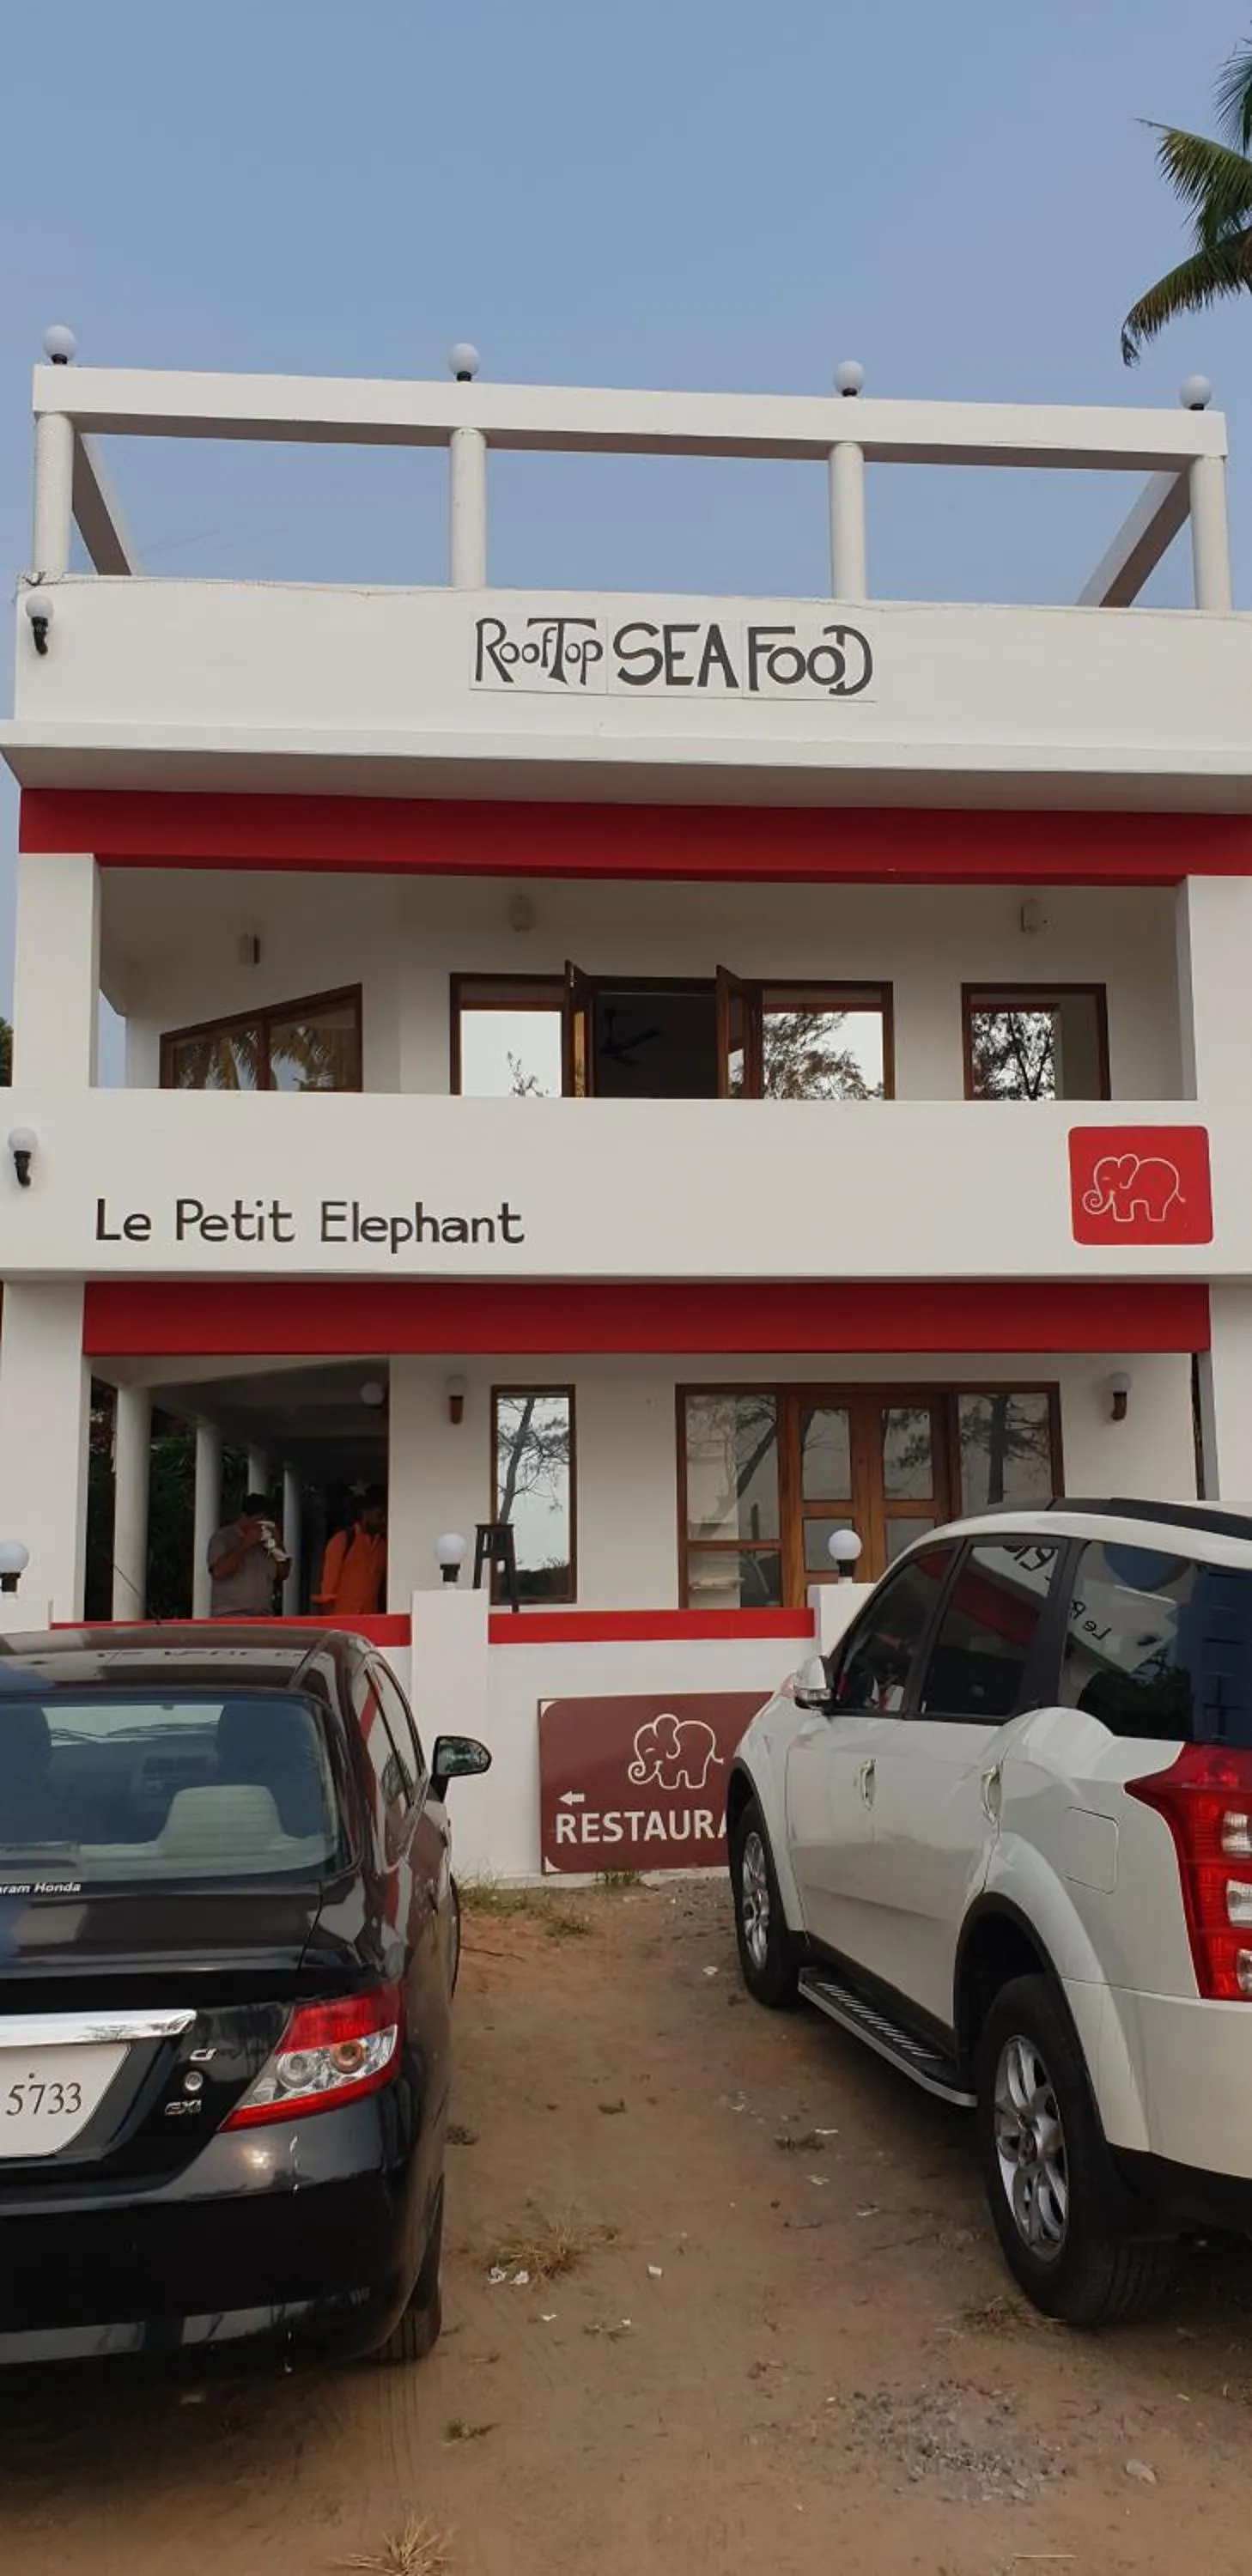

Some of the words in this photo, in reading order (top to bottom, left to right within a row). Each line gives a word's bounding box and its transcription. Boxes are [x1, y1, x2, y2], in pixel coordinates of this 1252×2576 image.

[612, 623, 739, 689] SEA
[95, 1198, 152, 1242] Le
[176, 1198, 295, 1242] Petit
[320, 1200, 526, 1255] Elephant
[0, 1884, 31, 1895] ram
[34, 1881, 82, 1893] Honda
[5, 2082, 82, 2116] 5733
